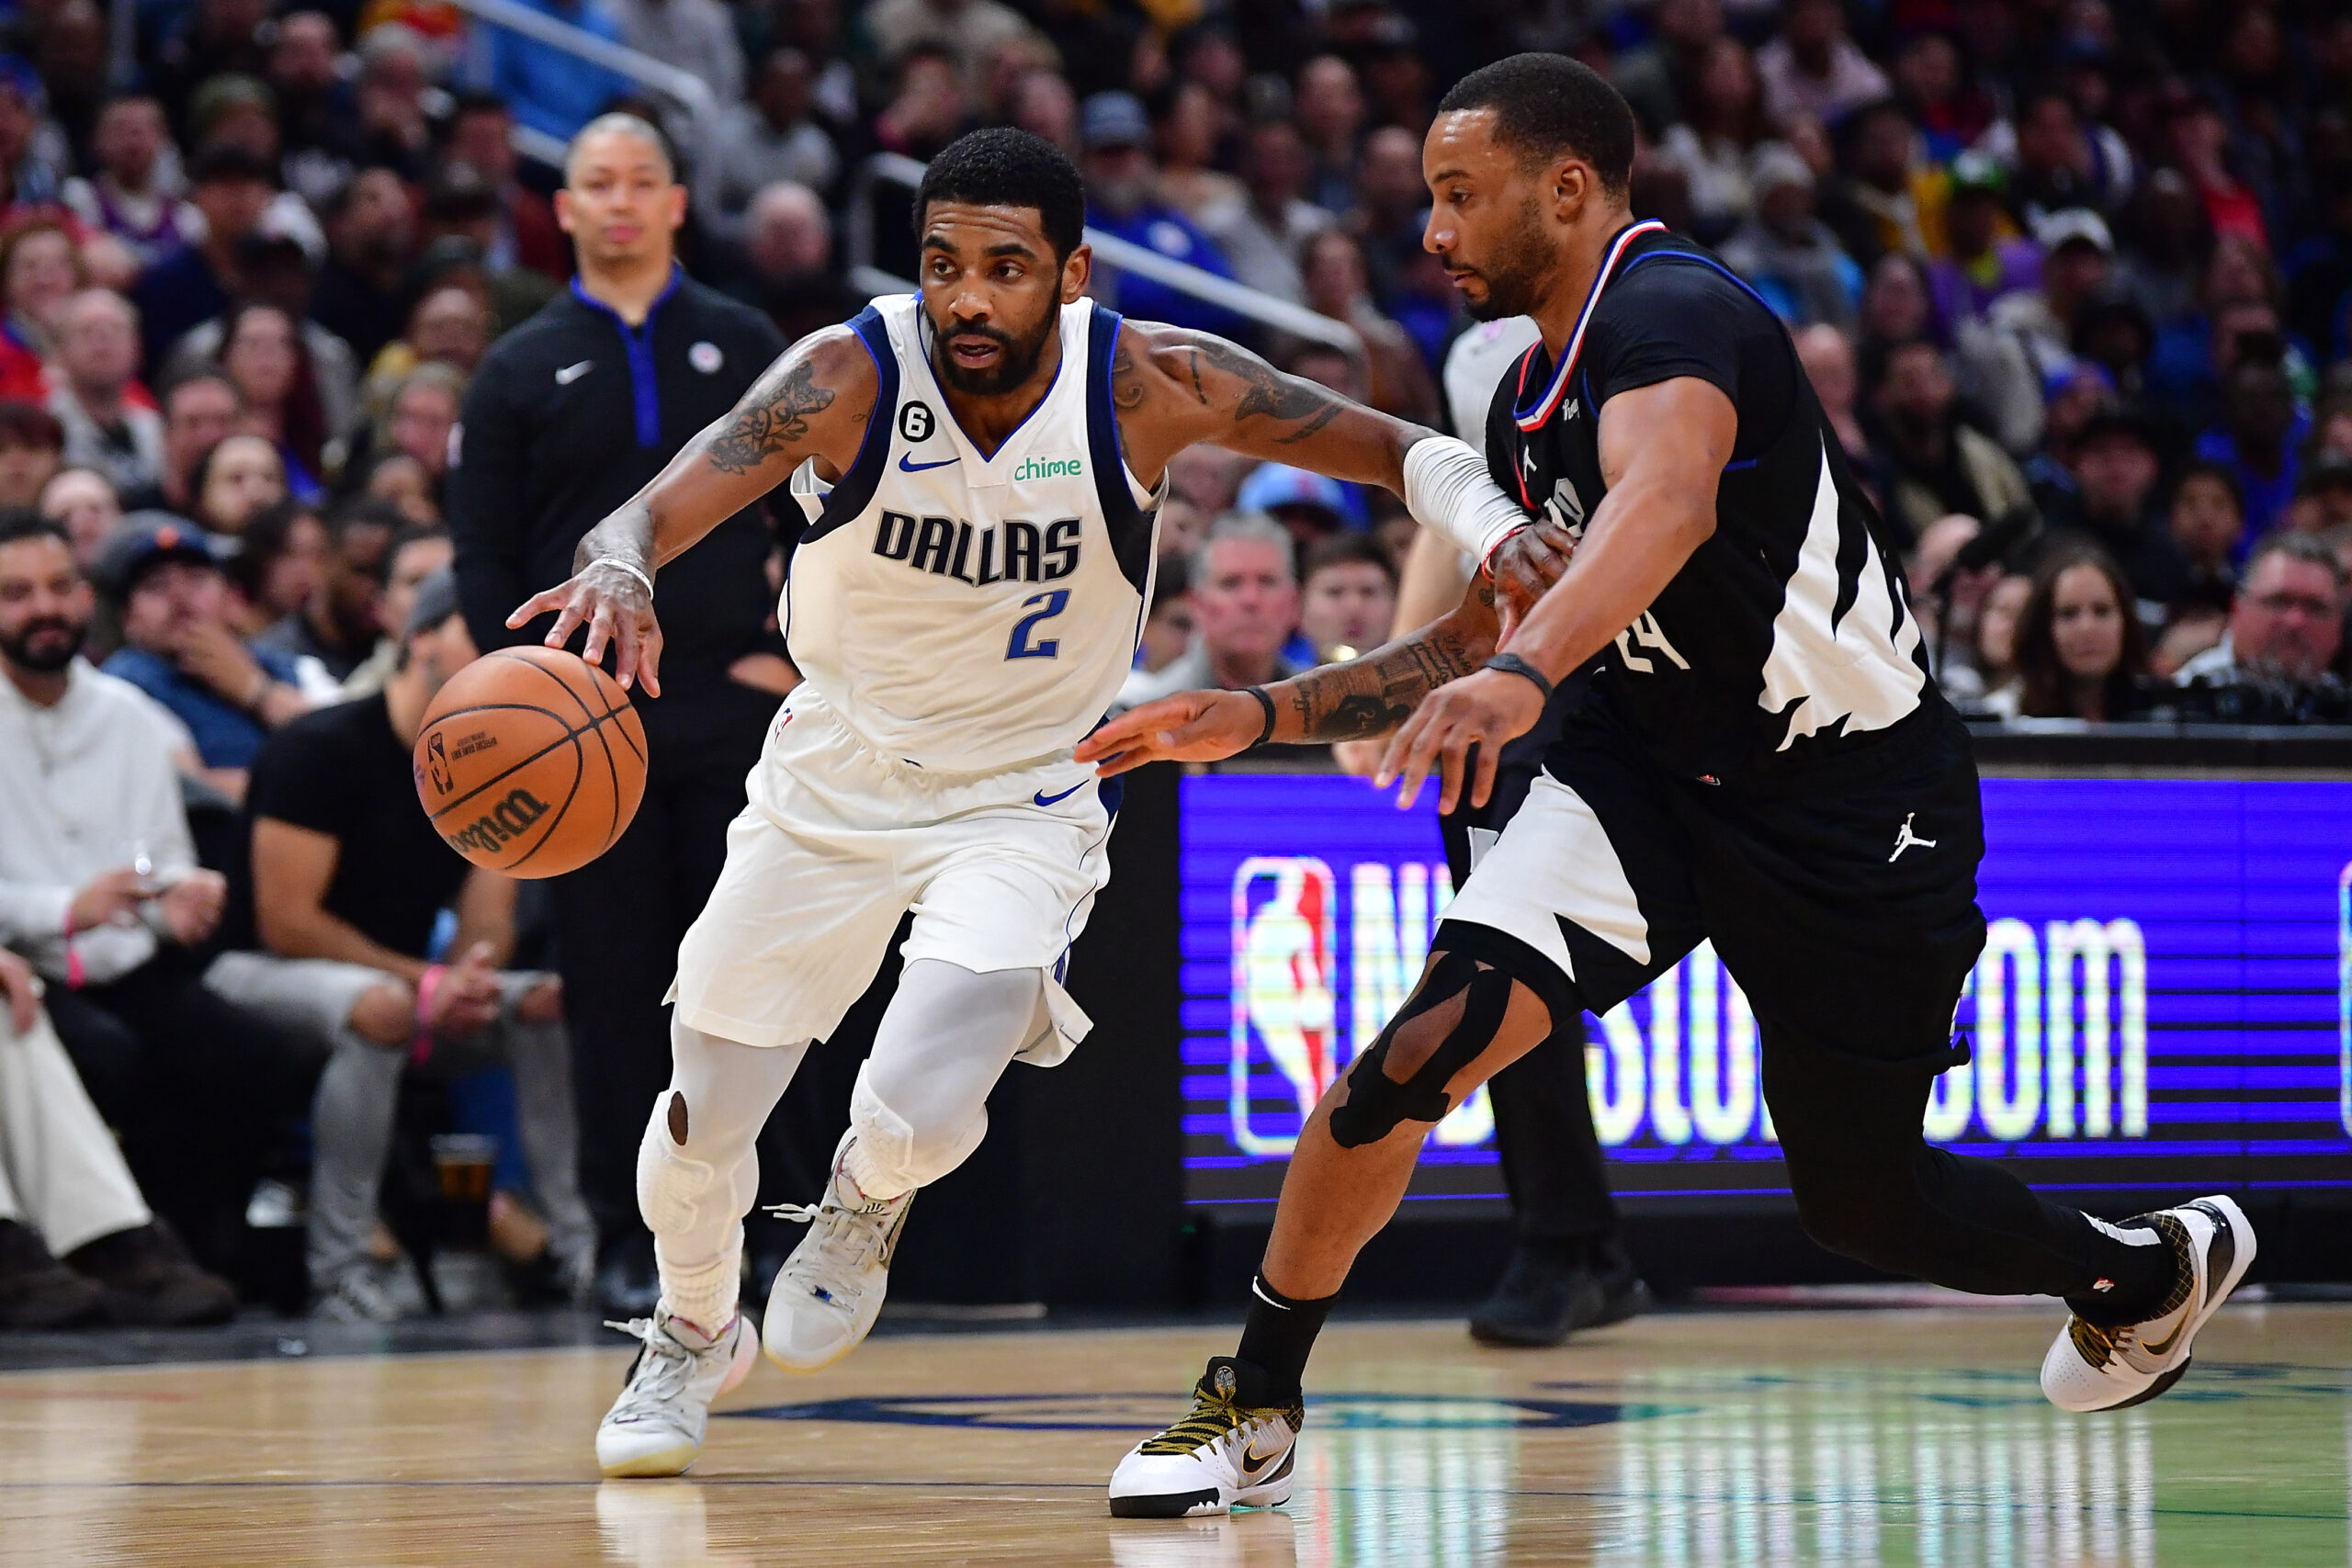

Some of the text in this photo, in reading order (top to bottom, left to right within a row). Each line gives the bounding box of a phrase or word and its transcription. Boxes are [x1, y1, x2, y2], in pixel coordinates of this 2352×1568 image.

[905, 406, 928, 438] 6
[1014, 457, 1082, 481] chime
[872, 507, 1082, 587] DALLAS
[1004, 588, 1072, 661] 2
